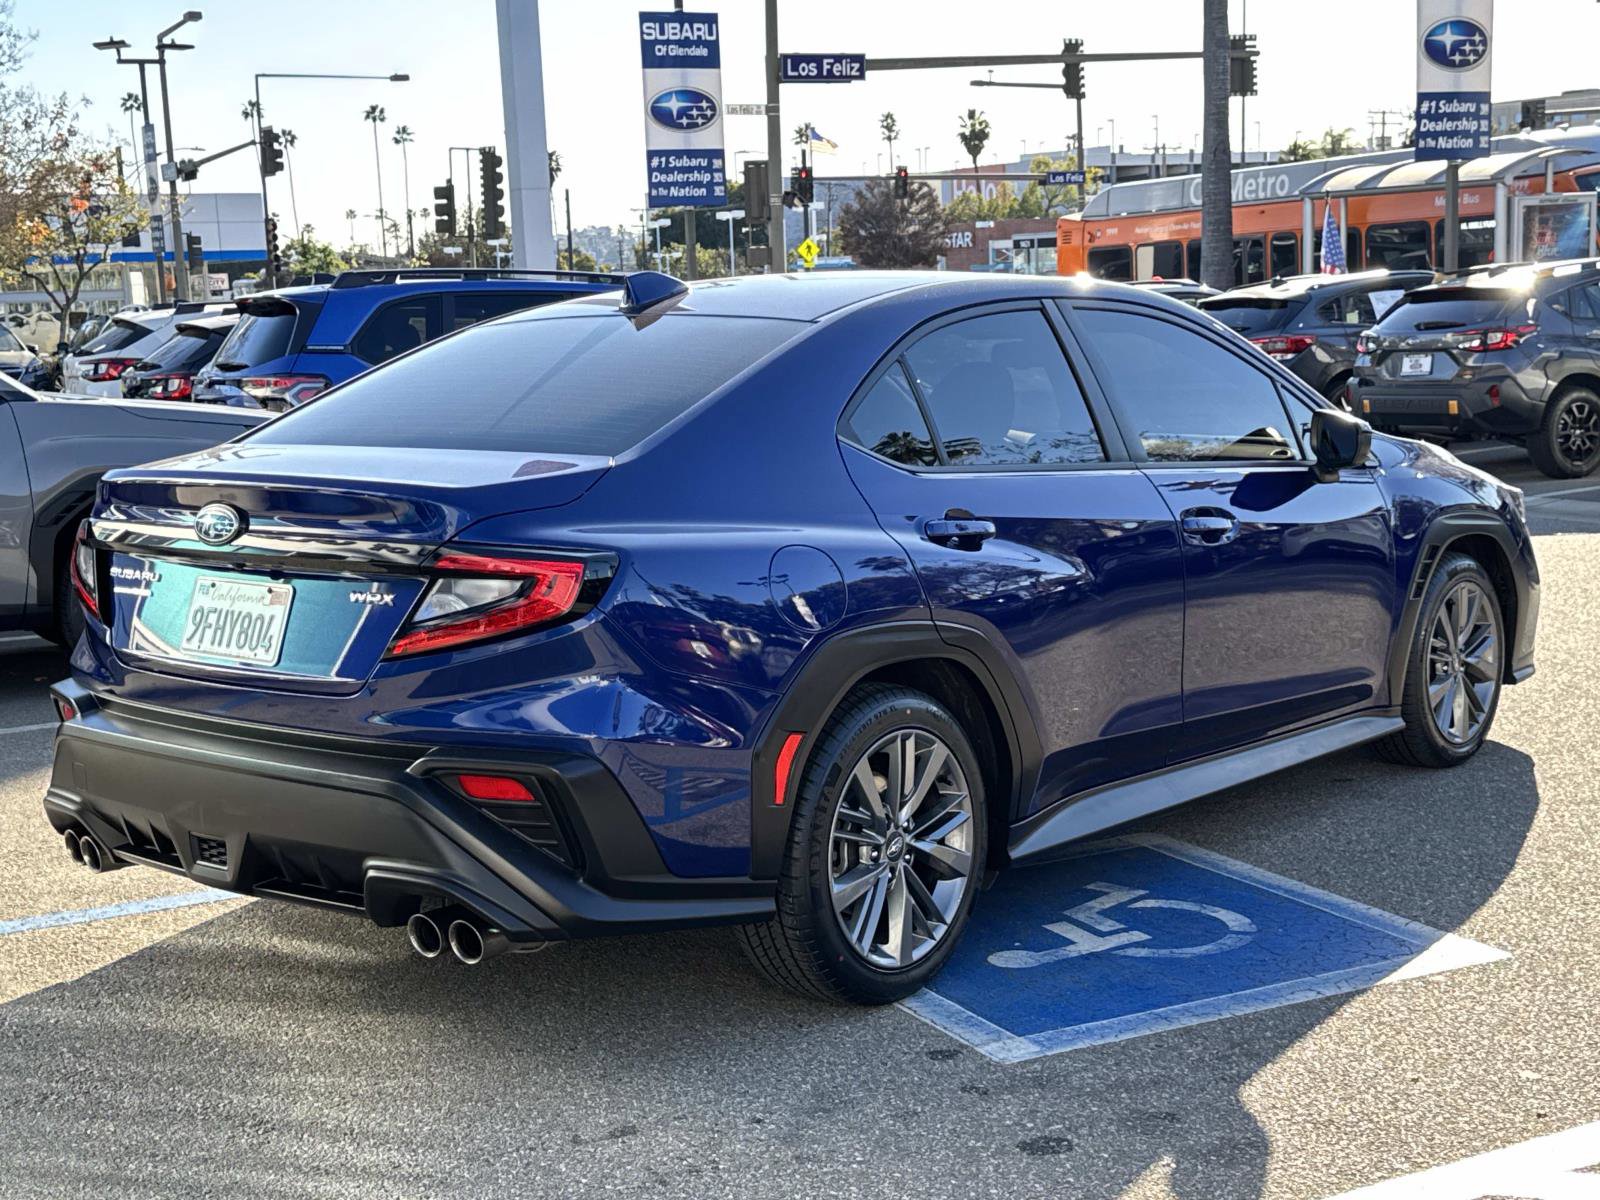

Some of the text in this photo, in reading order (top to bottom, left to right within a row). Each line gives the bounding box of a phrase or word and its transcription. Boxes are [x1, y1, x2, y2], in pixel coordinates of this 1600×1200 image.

[642, 22, 717, 41] SUBARU
[655, 45, 709, 57] Of Glendale
[787, 58, 860, 76] Los Feliz
[1420, 98, 1477, 115] #1 Subaru
[1420, 117, 1479, 134] Dealership
[1437, 135, 1473, 150] Nation
[651, 155, 708, 169] #1 Subaru
[652, 170, 712, 184] Dealership
[1050, 171, 1084, 183] Los Feliz
[669, 185, 707, 198] Nation
[1231, 171, 1290, 202] Metro
[1463, 193, 1480, 205] Bus
[110, 566, 160, 582] SUBARU
[211, 584, 265, 608] California
[186, 605, 275, 654] 9FHY804
